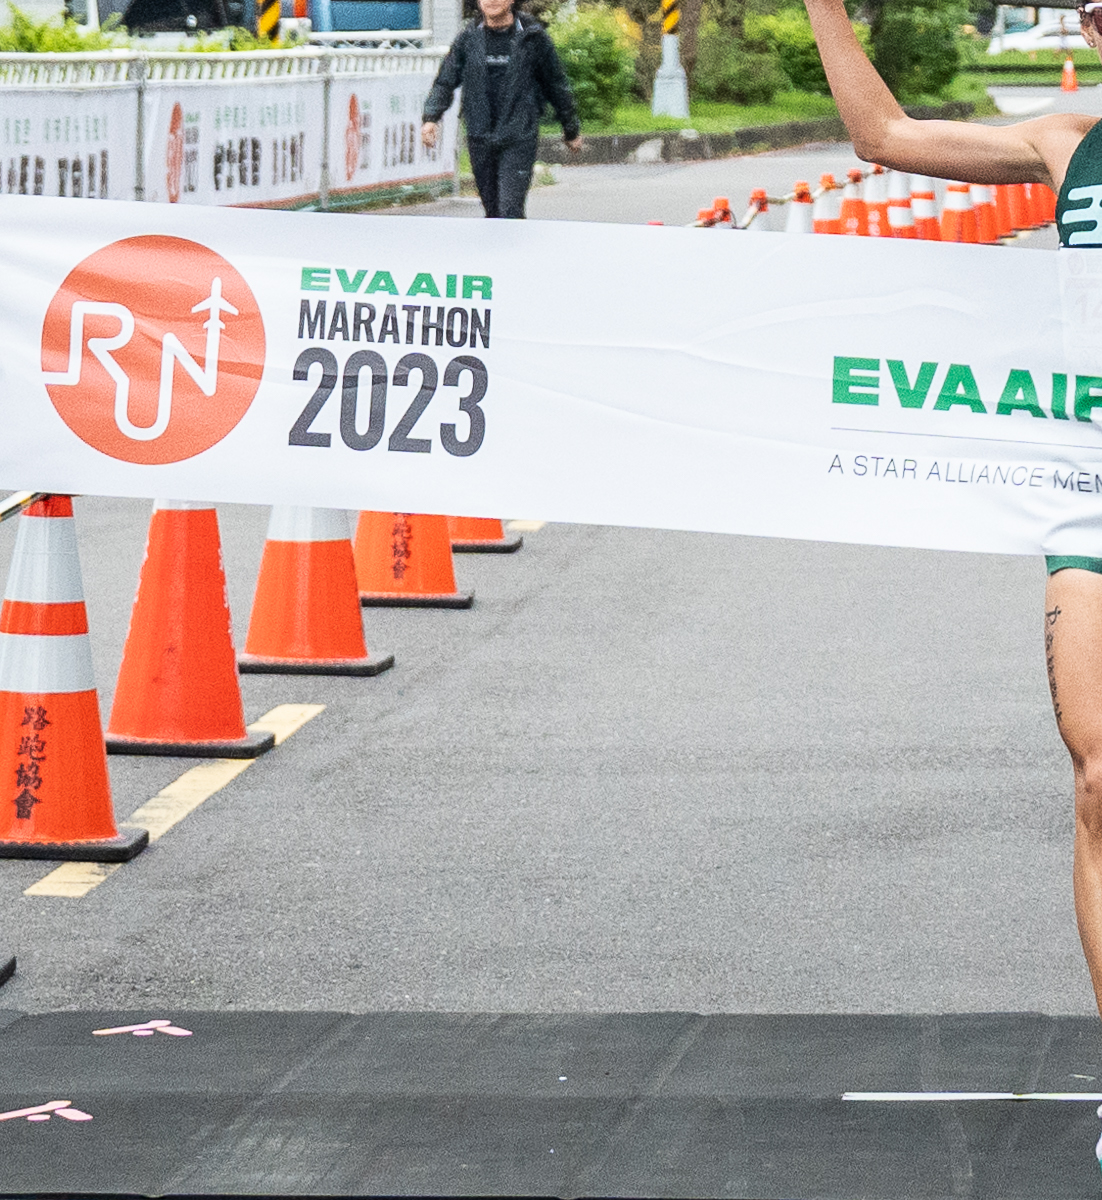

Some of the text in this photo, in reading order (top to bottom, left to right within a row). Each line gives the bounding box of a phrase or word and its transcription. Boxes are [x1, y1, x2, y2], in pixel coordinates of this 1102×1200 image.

[298, 299, 492, 349] MARATHON
[288, 346, 489, 458] 2023
[828, 454, 844, 474] A
[853, 455, 918, 479] STAR
[926, 461, 1045, 488] ALLIANCE
